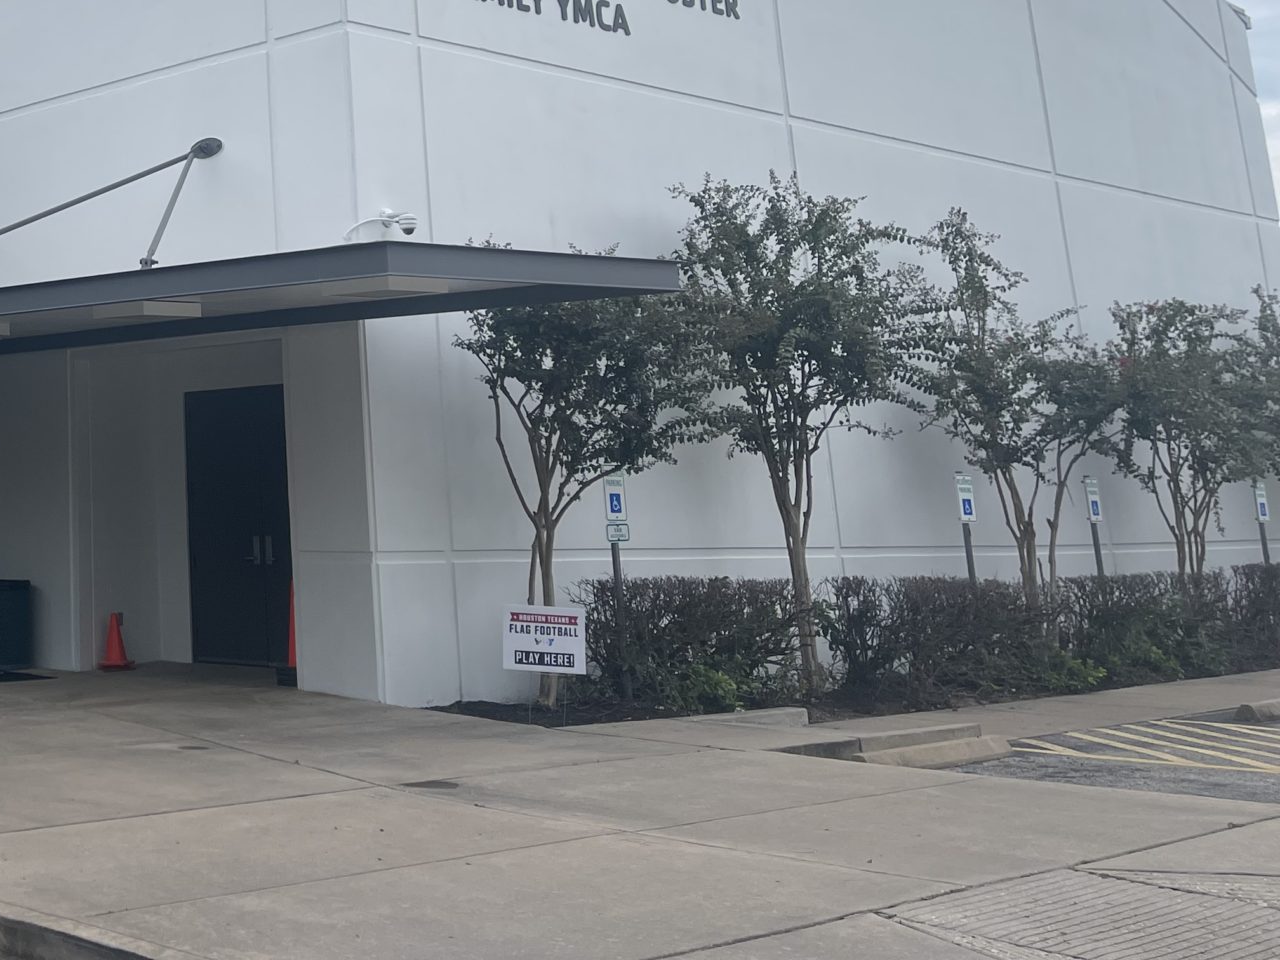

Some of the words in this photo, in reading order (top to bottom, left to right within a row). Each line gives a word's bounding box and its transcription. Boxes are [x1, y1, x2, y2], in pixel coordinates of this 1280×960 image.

[519, 614, 546, 622] HOUSTON
[547, 616, 570, 624] TEXANS
[510, 624, 531, 634] FLAG
[535, 625, 578, 637] FOOTBALL
[516, 652, 540, 664] PLAY
[544, 654, 573, 666] HERE!
